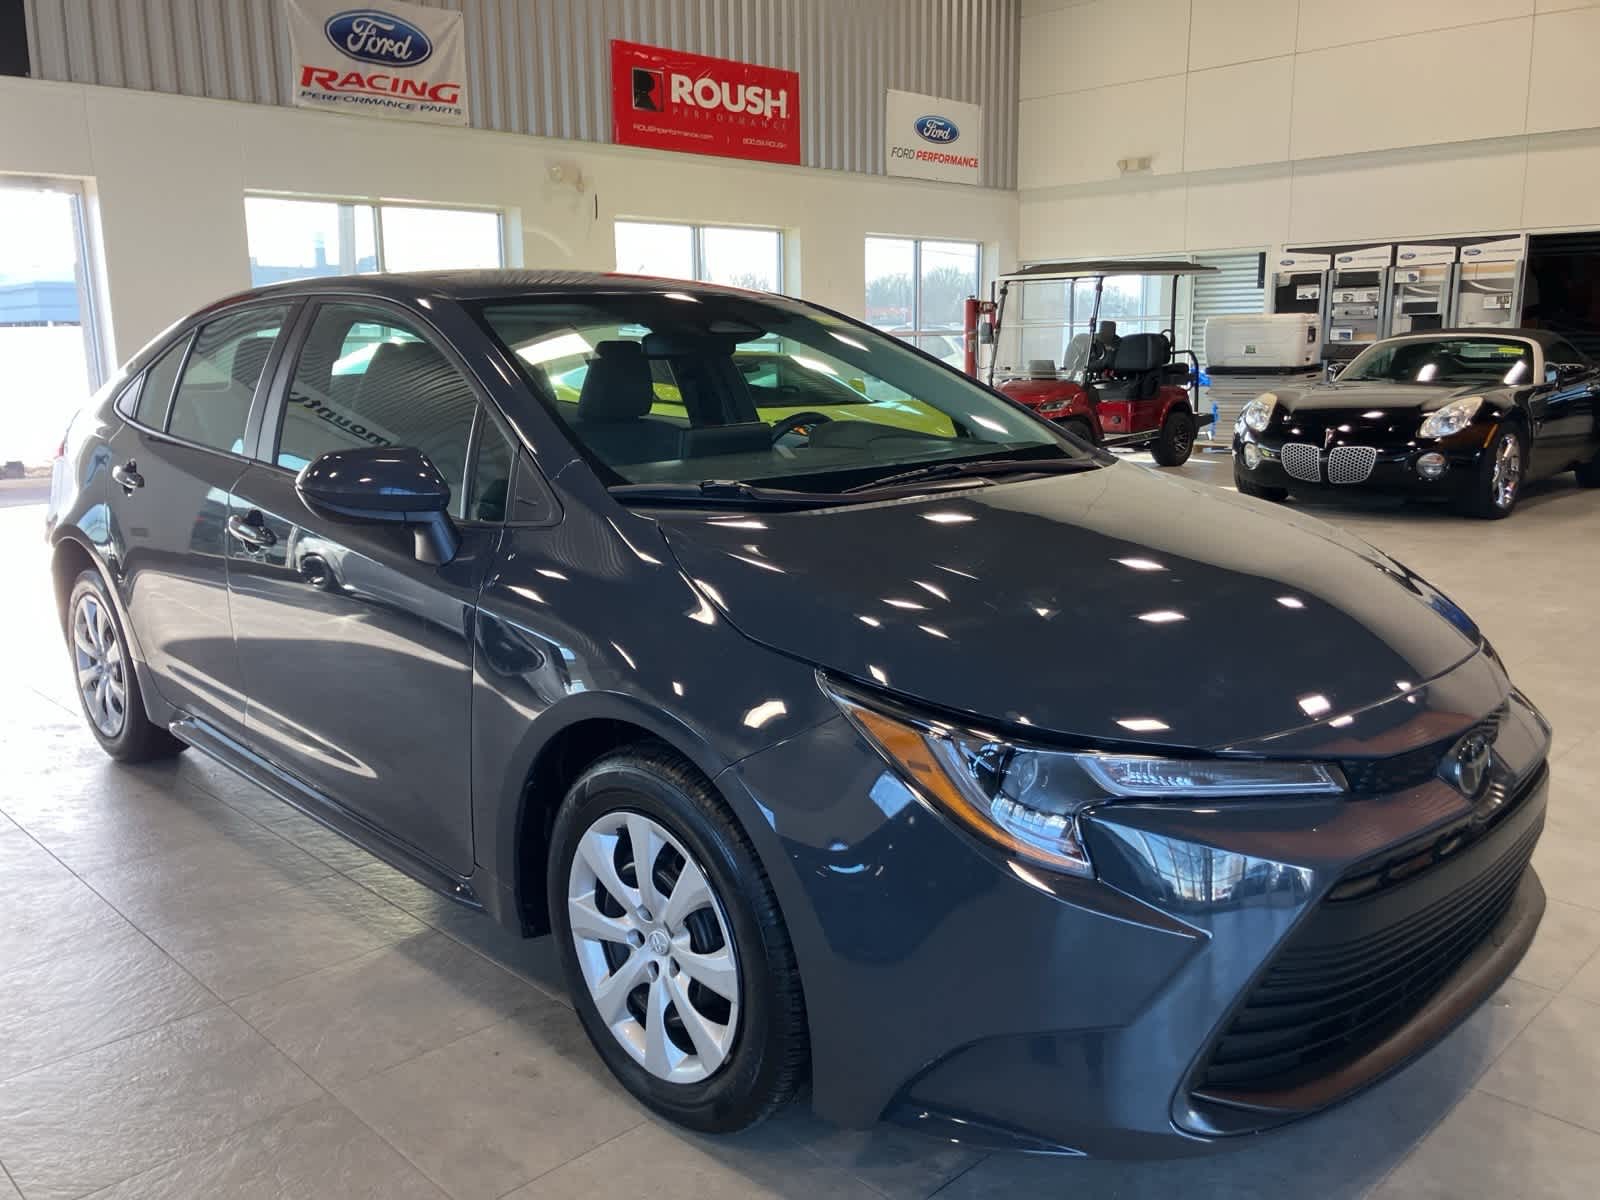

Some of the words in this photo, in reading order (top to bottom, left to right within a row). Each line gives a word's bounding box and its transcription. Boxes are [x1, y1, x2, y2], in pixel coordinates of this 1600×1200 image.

[347, 17, 412, 60] Ford
[301, 66, 461, 104] RACING
[670, 73, 788, 120] ROUSH
[301, 90, 416, 111] PERFORMANCE
[419, 104, 462, 116] PARTS
[923, 119, 952, 140] Ford
[891, 146, 915, 160] FORD
[916, 150, 979, 169] PERFORMANCE
